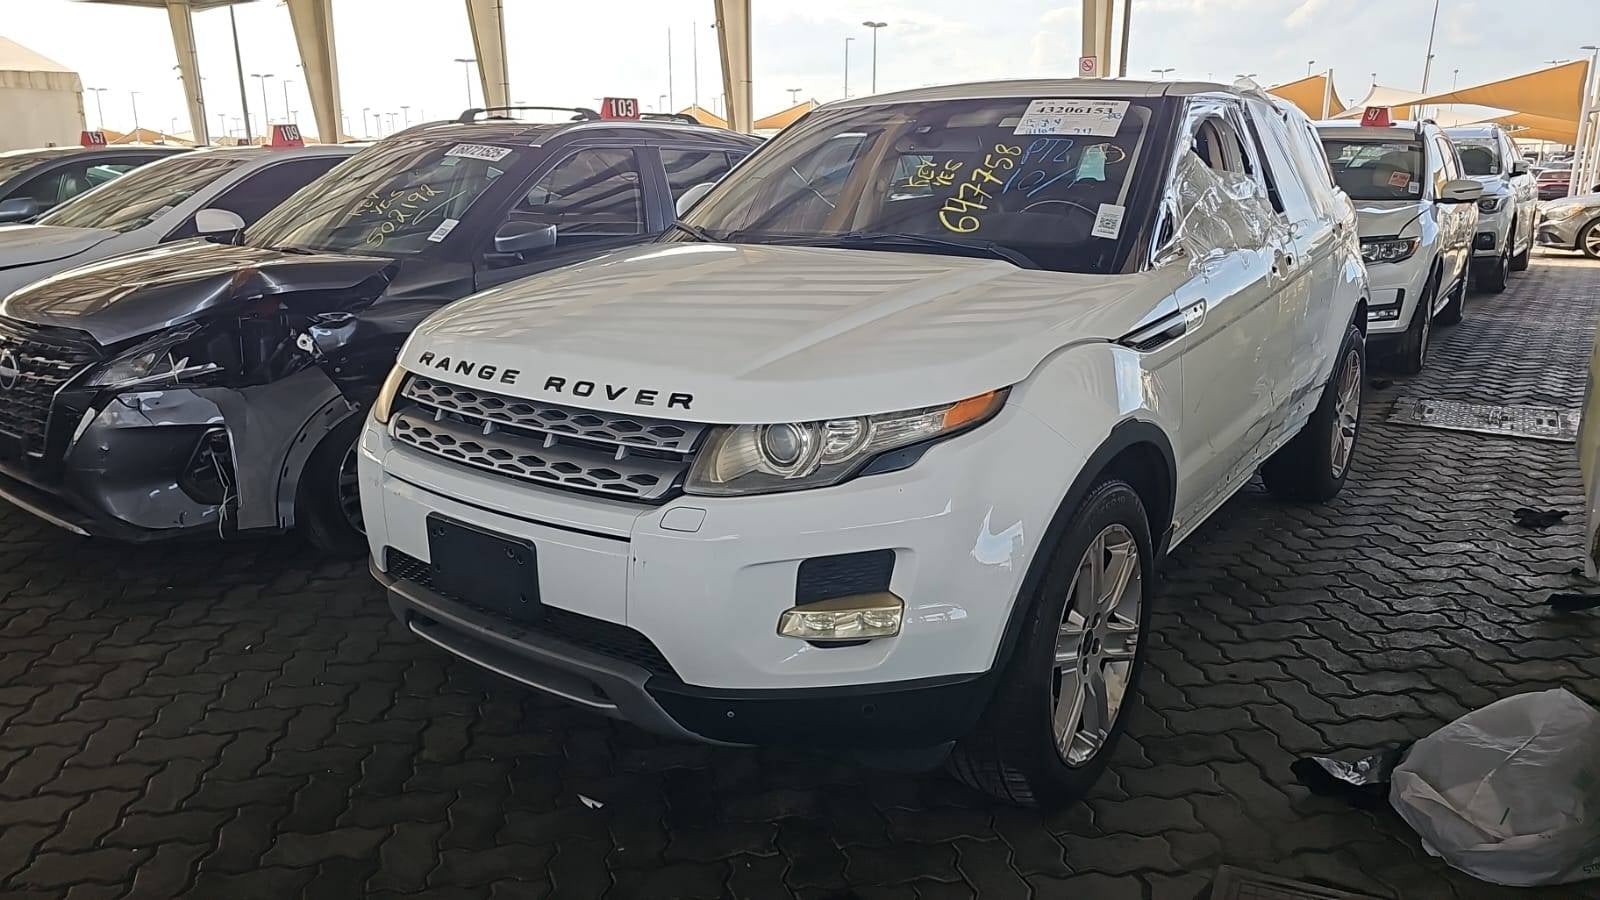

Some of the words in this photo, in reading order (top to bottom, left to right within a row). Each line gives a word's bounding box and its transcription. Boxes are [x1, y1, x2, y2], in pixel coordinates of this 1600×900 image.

[611, 99, 634, 117] 103
[1037, 106, 1113, 115] 43206153
[1367, 109, 1380, 121] 97
[87, 132, 104, 144] 157
[280, 125, 300, 141] 109
[939, 143, 1022, 232] 647758
[366, 183, 445, 248] 502192
[419, 351, 521, 385] RANGE
[543, 376, 694, 410] ROVER
